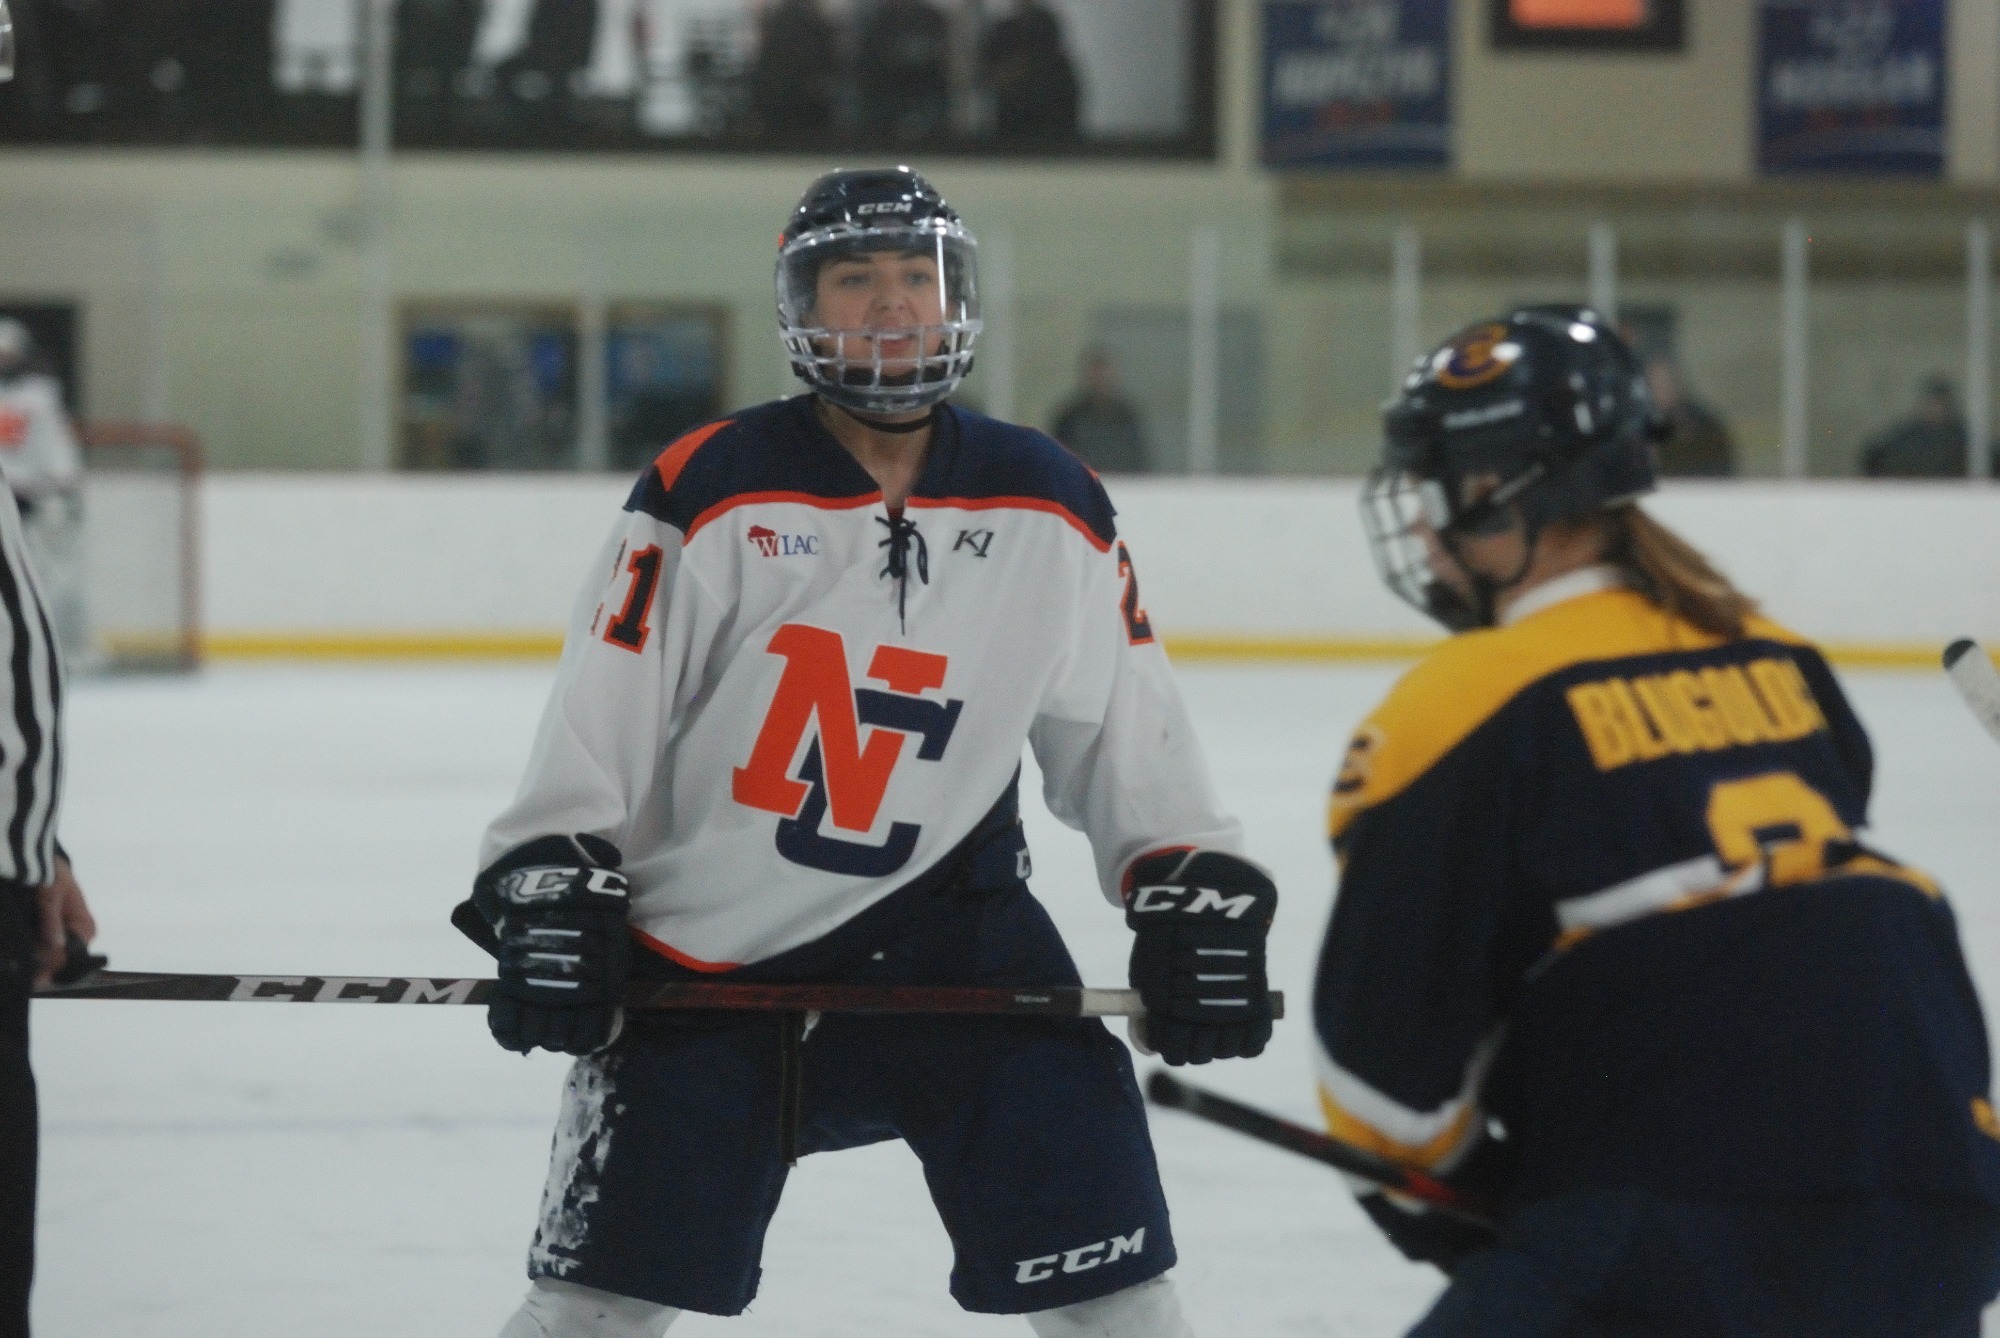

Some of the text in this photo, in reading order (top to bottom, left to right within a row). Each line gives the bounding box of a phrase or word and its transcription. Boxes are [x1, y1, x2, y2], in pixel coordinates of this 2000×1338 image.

[857, 202, 912, 215] CCM
[751, 533, 819, 557] WIAC
[952, 528, 995, 558] KI
[591, 539, 663, 654] 1
[1126, 885, 1256, 919] CM
[228, 976, 479, 1004] CCM
[1015, 1227, 1146, 1284] CCM
